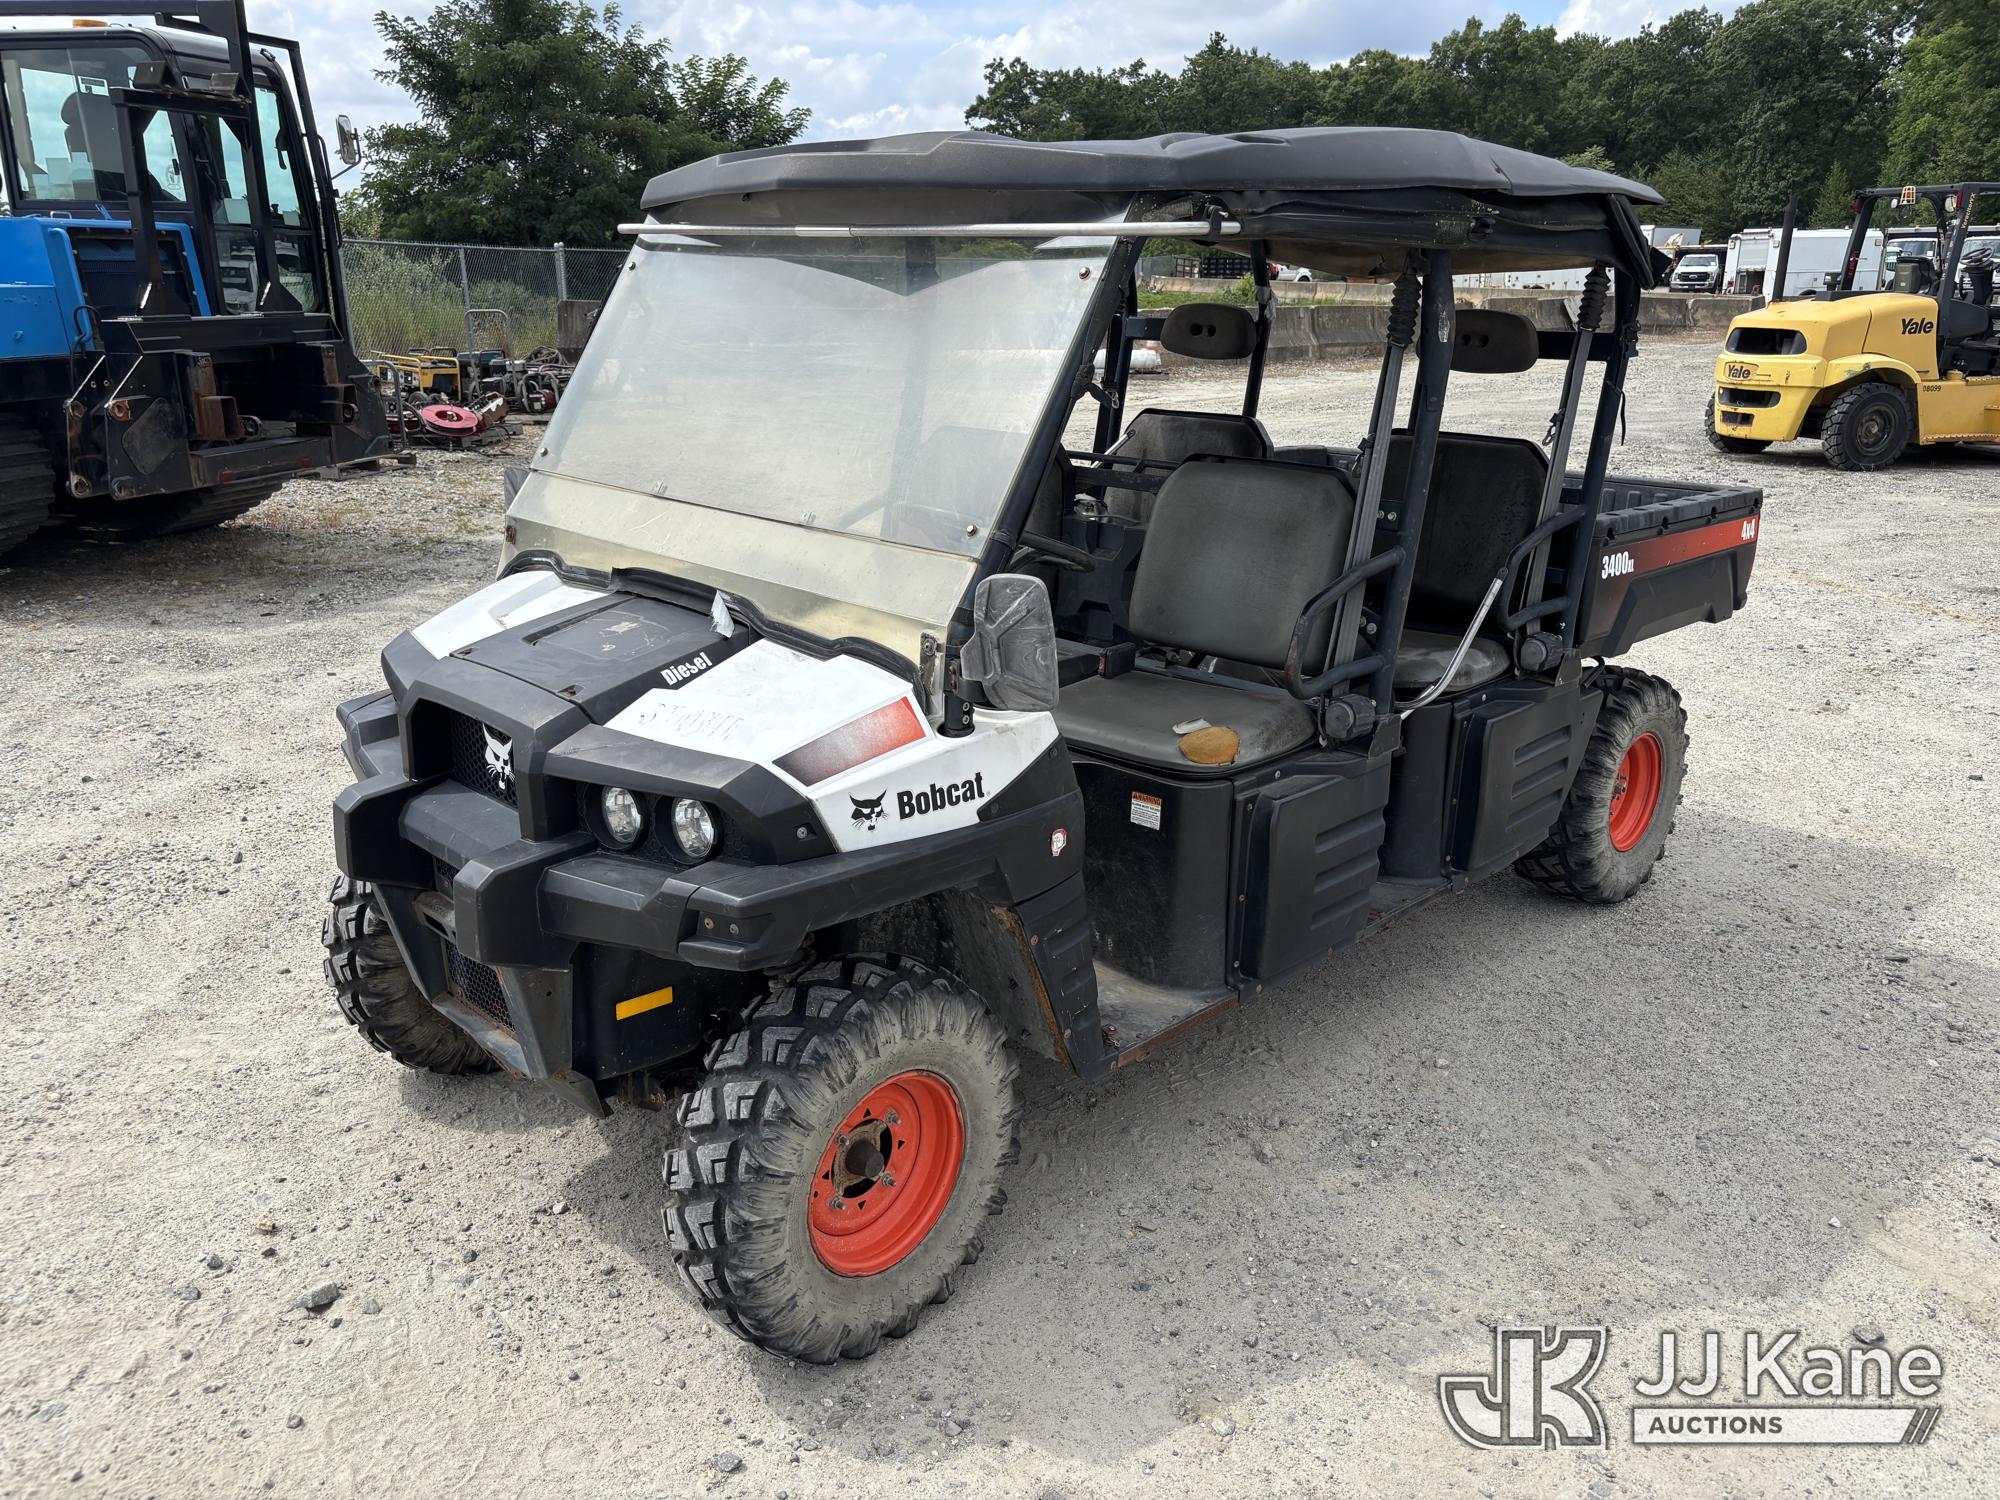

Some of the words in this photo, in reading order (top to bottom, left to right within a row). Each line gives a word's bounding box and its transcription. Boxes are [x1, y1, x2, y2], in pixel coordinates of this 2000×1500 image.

[1901, 318, 1934, 335] Yale
[1728, 364, 1751, 379] Yale
[1741, 519, 1756, 541] 4x4
[660, 651, 713, 686] Diesel
[897, 772, 985, 820] Bobcat
